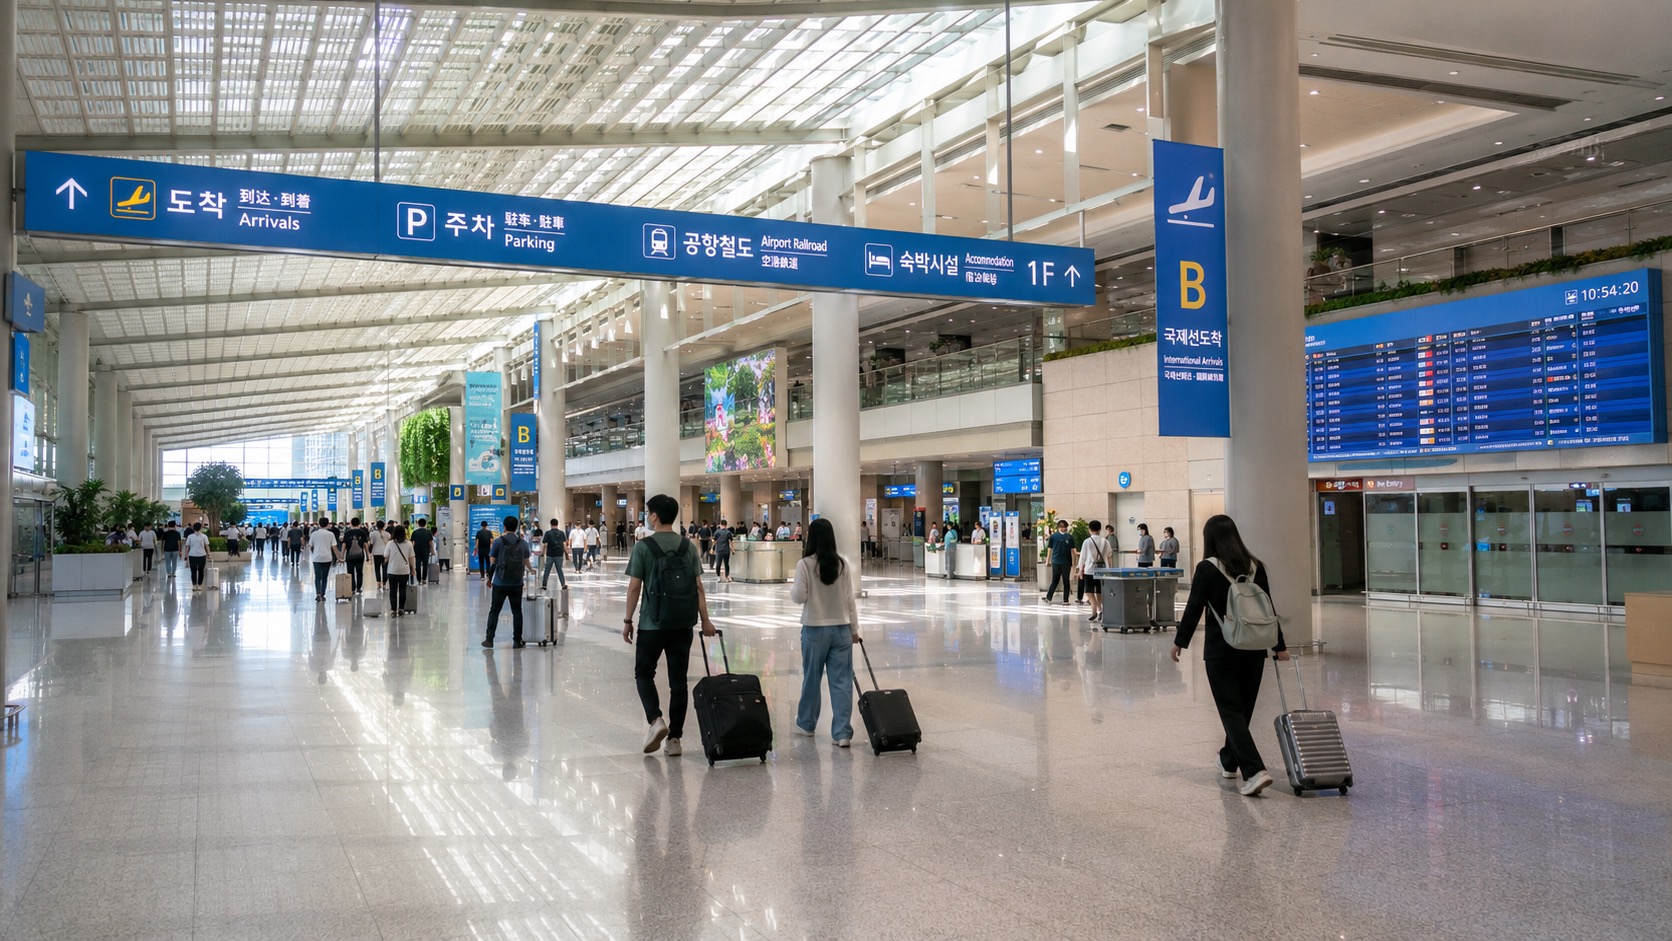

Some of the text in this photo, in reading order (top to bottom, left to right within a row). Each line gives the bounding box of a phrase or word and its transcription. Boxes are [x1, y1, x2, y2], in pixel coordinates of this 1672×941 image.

[167, 189, 228, 220] 도착
[239, 212, 300, 231] Arrivals
[407, 207, 428, 236] P
[444, 212, 496, 240] 주차
[504, 233, 556, 253] Parking
[683, 232, 754, 259] 공항철도
[761, 235, 792, 250] Airport
[899, 250, 959, 276] 숙박시설
[1027, 260, 1055, 287] 1F
[1179, 260, 1207, 310] B
[1581, 280, 1639, 301] 10:54:20
[1163, 327, 1223, 348] 국제선도착
[518, 425, 530, 443] B
